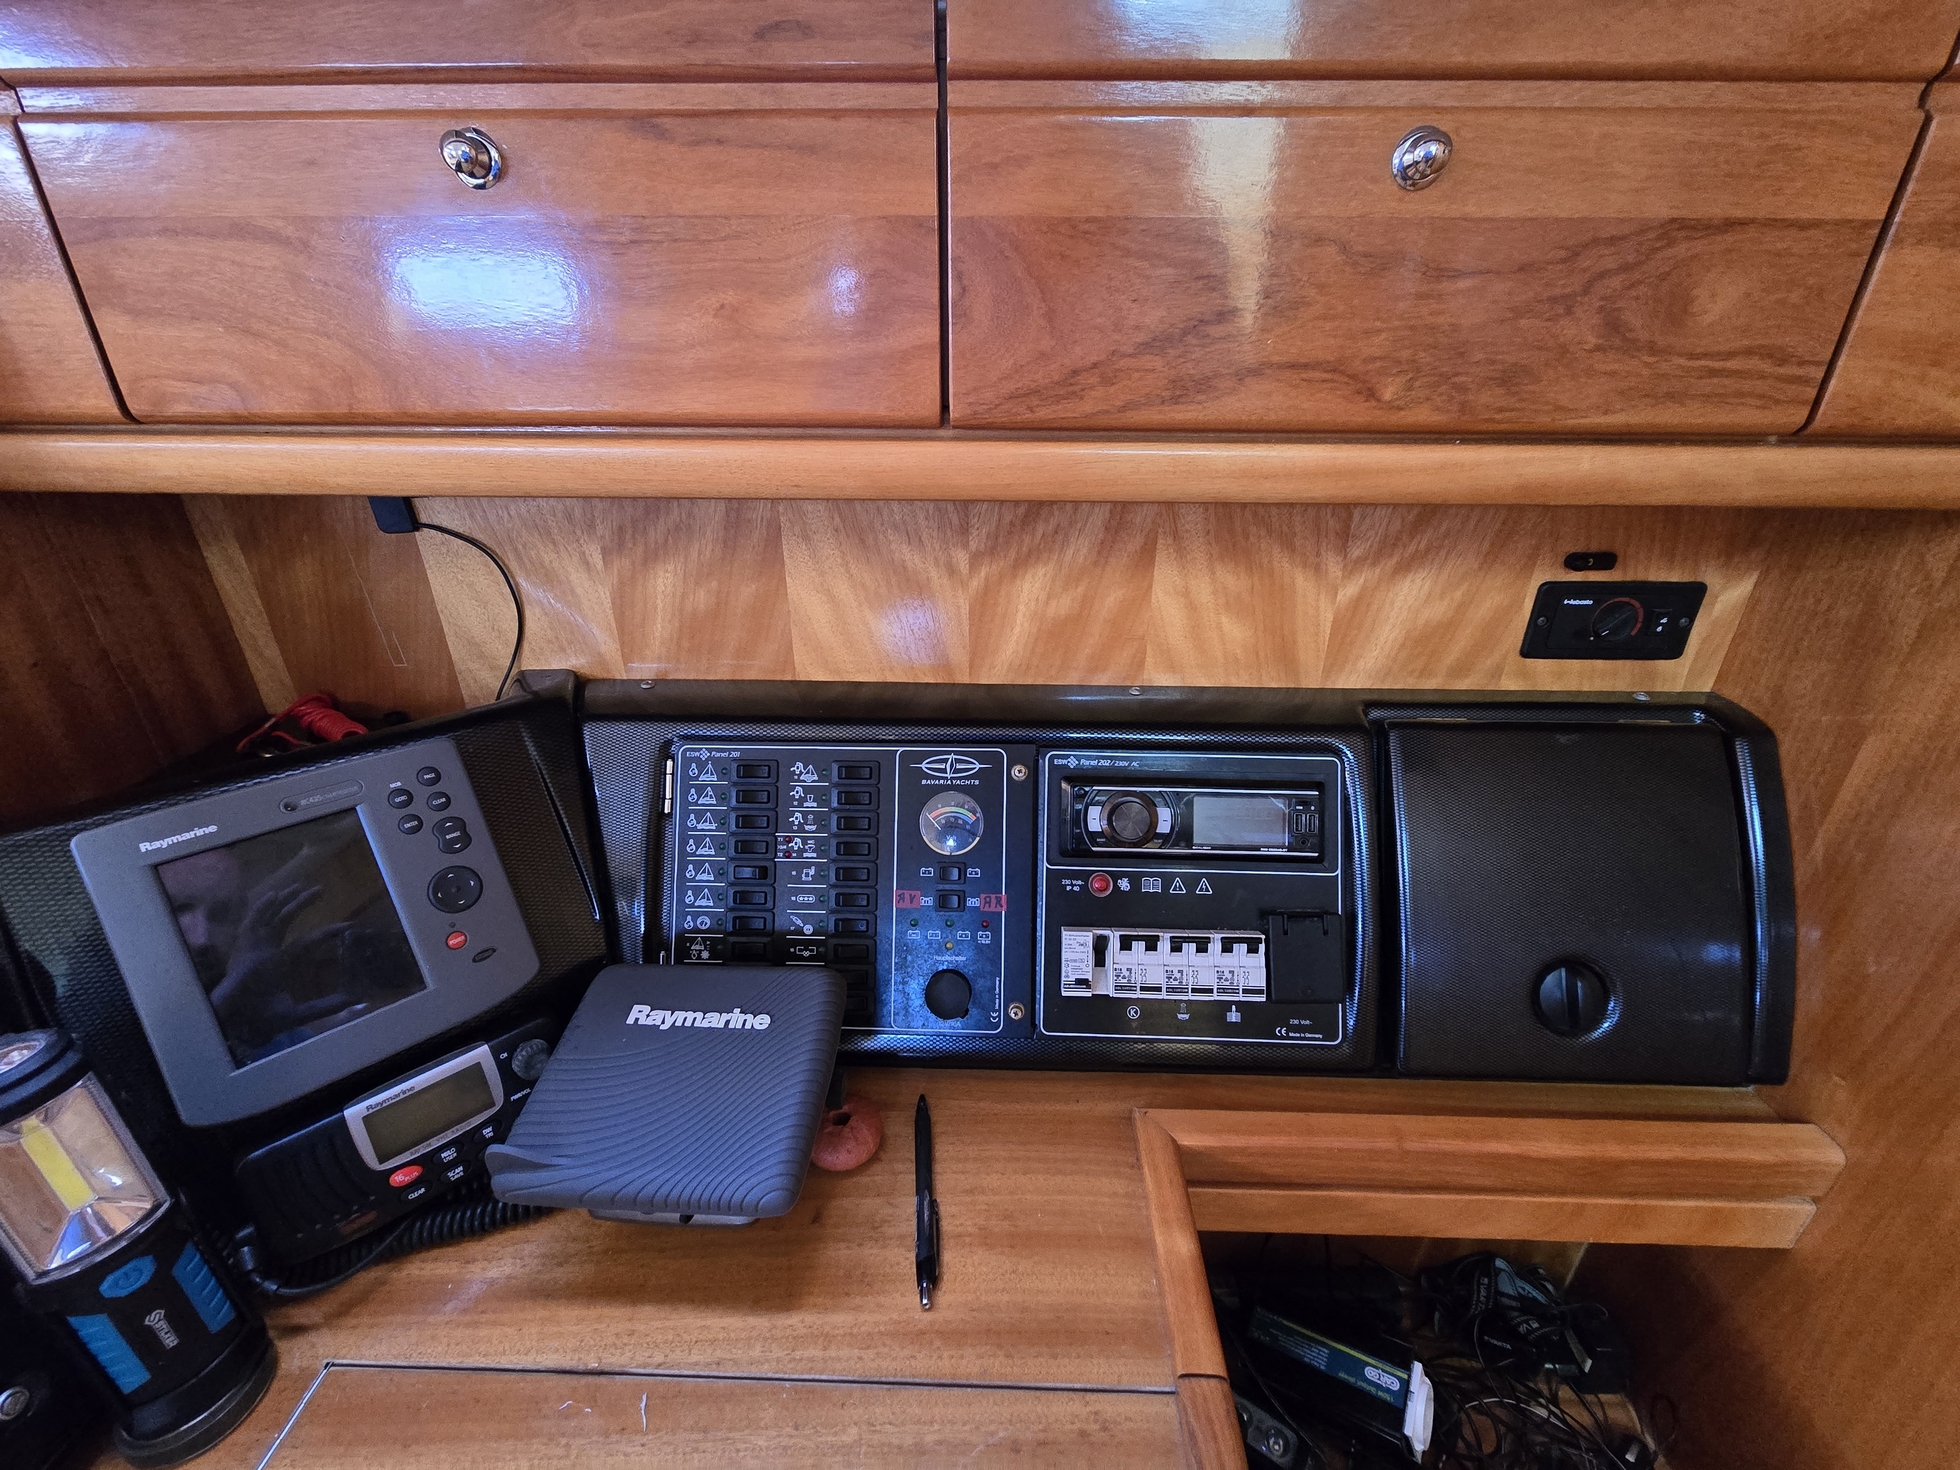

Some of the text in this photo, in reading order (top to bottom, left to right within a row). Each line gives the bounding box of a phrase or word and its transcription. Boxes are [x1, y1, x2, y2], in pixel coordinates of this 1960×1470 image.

[432, 797, 446, 805] CLEAR
[139, 825, 218, 852] Raymarine
[446, 831, 461, 840] RANGE
[898, 892, 916, 904] AV
[626, 1004, 771, 1030] Raymarine
[366, 1085, 416, 1112] Raymarine
[394, 1174, 404, 1182] 16
[447, 1165, 464, 1178] SCAN
[408, 1187, 426, 1200] CLEAR
